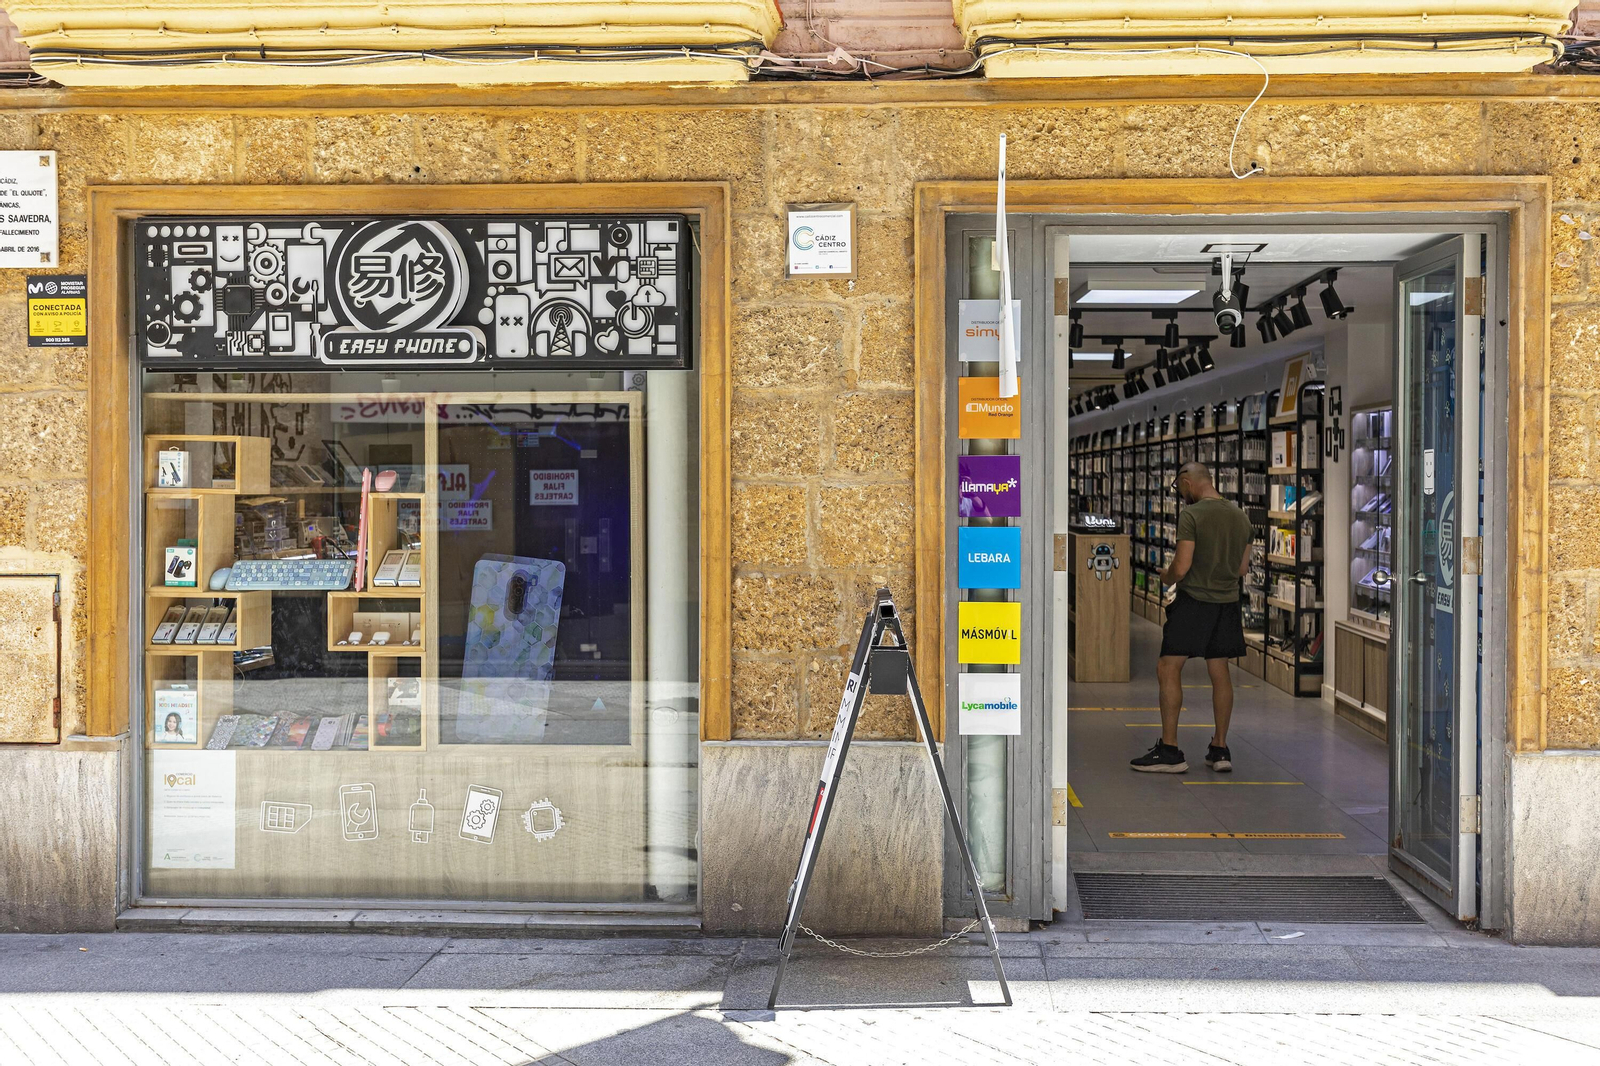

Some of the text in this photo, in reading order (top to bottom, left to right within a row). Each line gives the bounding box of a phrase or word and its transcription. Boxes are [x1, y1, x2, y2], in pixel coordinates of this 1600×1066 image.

[8, 214, 52, 224] SAAVEDRA,
[348, 242, 446, 308] 易修
[966, 325, 1000, 341] simy
[339, 338, 458, 354] EASY PHONE
[978, 403, 1014, 412] Mundo
[968, 553, 1011, 563] LEBARA
[962, 700, 1018, 711] Lycamobile
